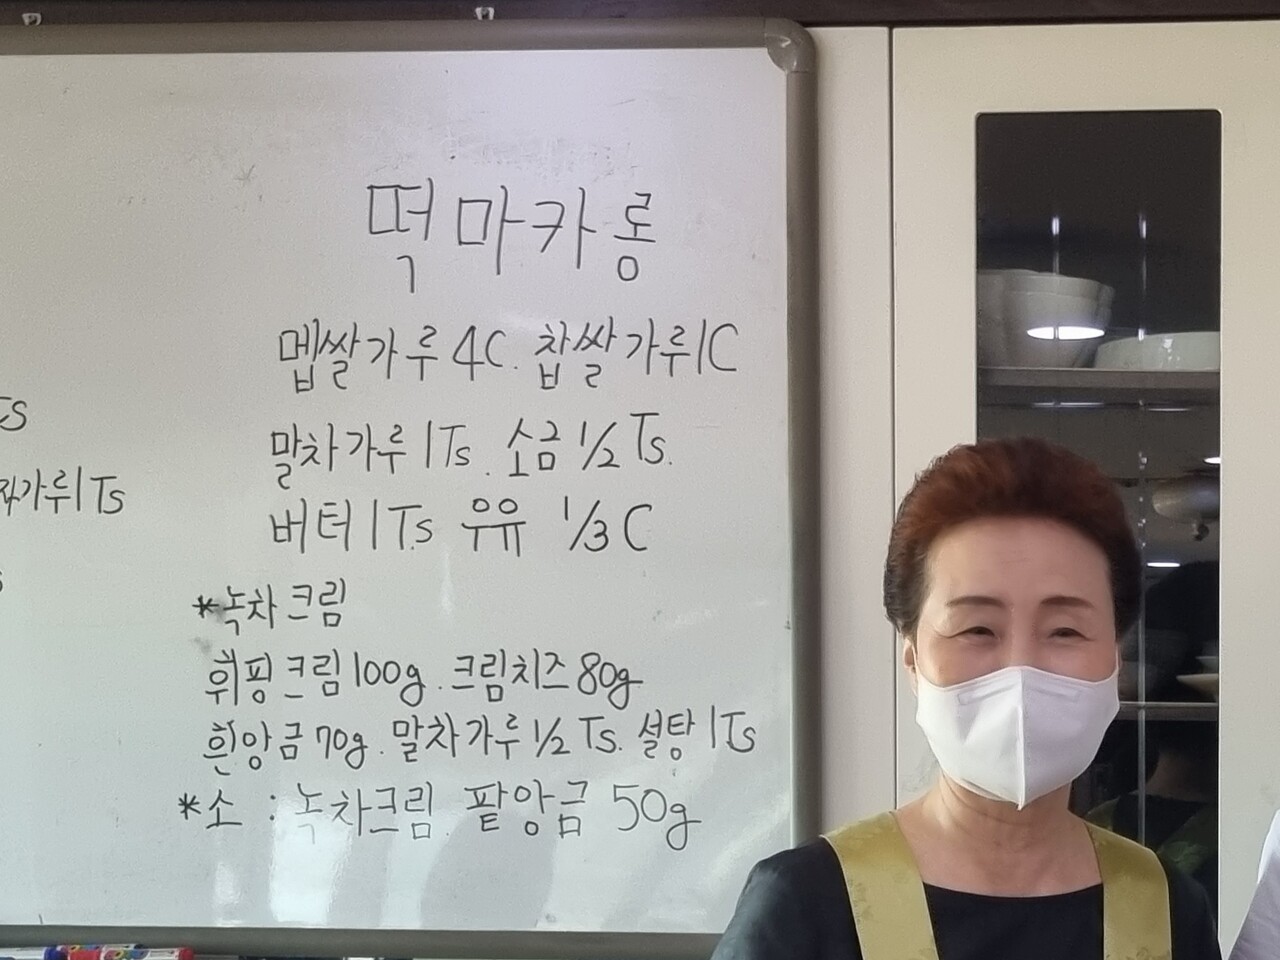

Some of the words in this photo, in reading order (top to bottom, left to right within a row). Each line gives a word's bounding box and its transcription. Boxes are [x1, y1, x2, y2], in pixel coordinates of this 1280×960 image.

[270, 423, 407, 490] 말차가루
[507, 417, 561, 477] 소금
[269, 498, 351, 554] 버터
[451, 648, 569, 702] 크림치즈
[577, 652, 644, 710] 80g
[392, 712, 520, 763] 말차가루
[638, 708, 695, 761] 설탕
[464, 779, 588, 839] 팥앙금
[613, 784, 702, 851] 50g
